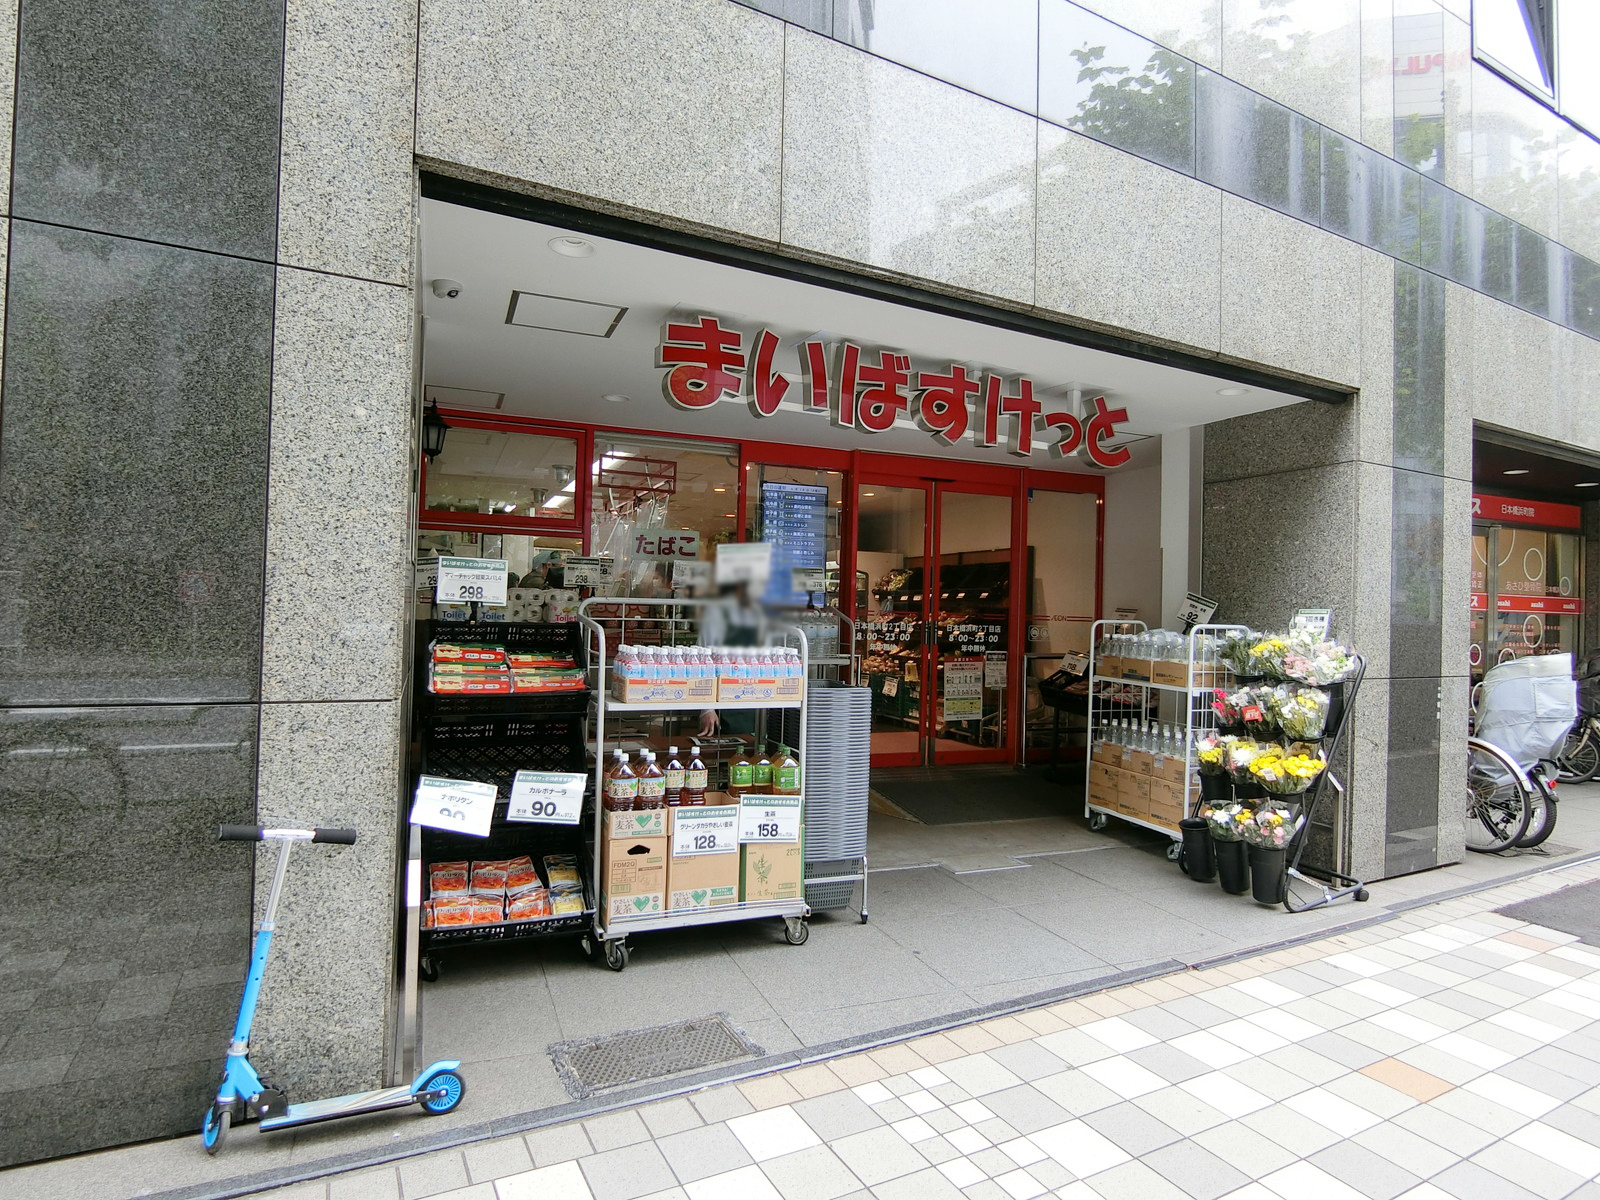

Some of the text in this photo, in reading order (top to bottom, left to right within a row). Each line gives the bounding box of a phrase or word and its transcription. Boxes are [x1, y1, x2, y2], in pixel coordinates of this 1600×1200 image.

[657, 315, 1132, 469] まいばすけっと
[635, 534, 697, 557] たばこ
[427, 575, 438, 586] 29
[459, 585, 484, 599] 298
[442, 610, 467, 619] Toilet
[481, 612, 505, 620] Toilet
[1186, 611, 1198, 623] 92
[528, 787, 567, 796] カルボナーラ
[612, 788, 629, 797] 麦茶
[640, 787, 657, 796] 麦茶
[441, 793, 473, 805] ナポリタン
[531, 800, 557, 817] 90
[615, 820, 634, 831] 麦茶
[757, 823, 778, 837] 158
[694, 834, 716, 849] 128
[673, 896, 691, 907] 麦茶
[613, 903, 632, 915] 麦茶
